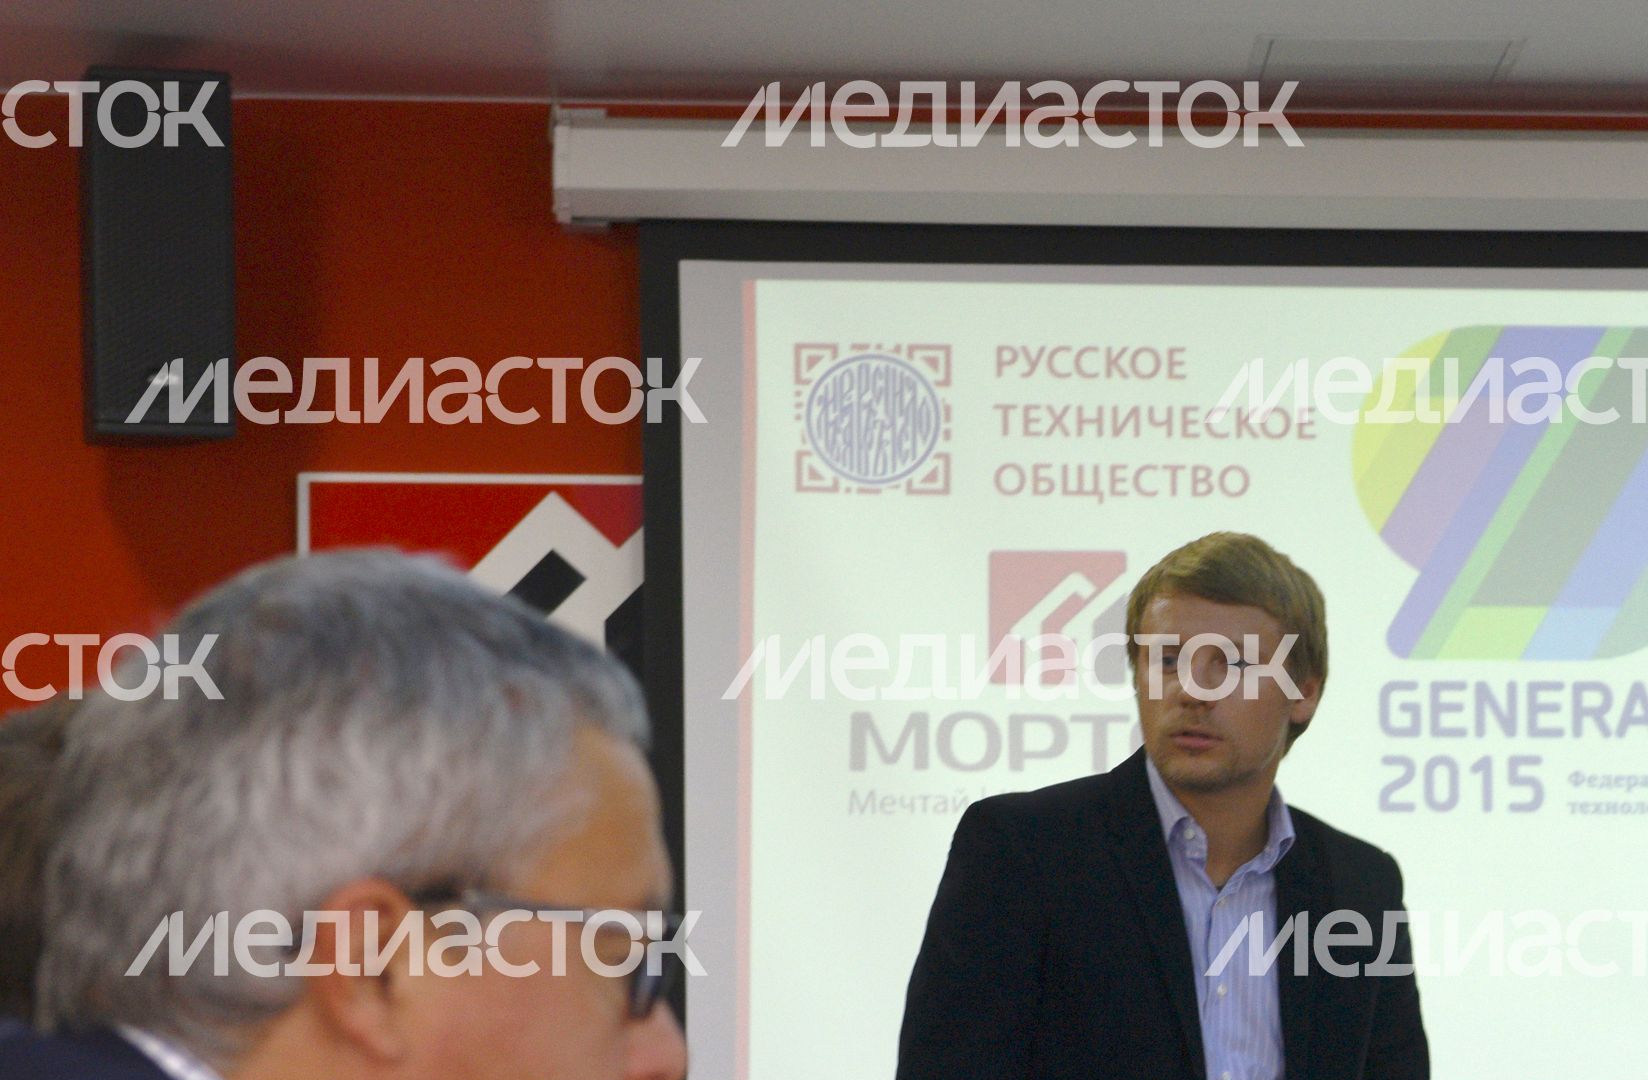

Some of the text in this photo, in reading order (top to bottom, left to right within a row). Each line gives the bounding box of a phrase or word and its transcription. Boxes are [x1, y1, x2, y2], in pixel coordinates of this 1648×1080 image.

[994, 346, 1187, 379] РУССКОЕ
[994, 404, 1317, 440] ТЕХНИЧЕСКОЕ
[992, 464, 1251, 504] ОБЩЕСТВО
[848, 710, 1144, 773] МОРТ
[1378, 754, 1545, 813] 2015
